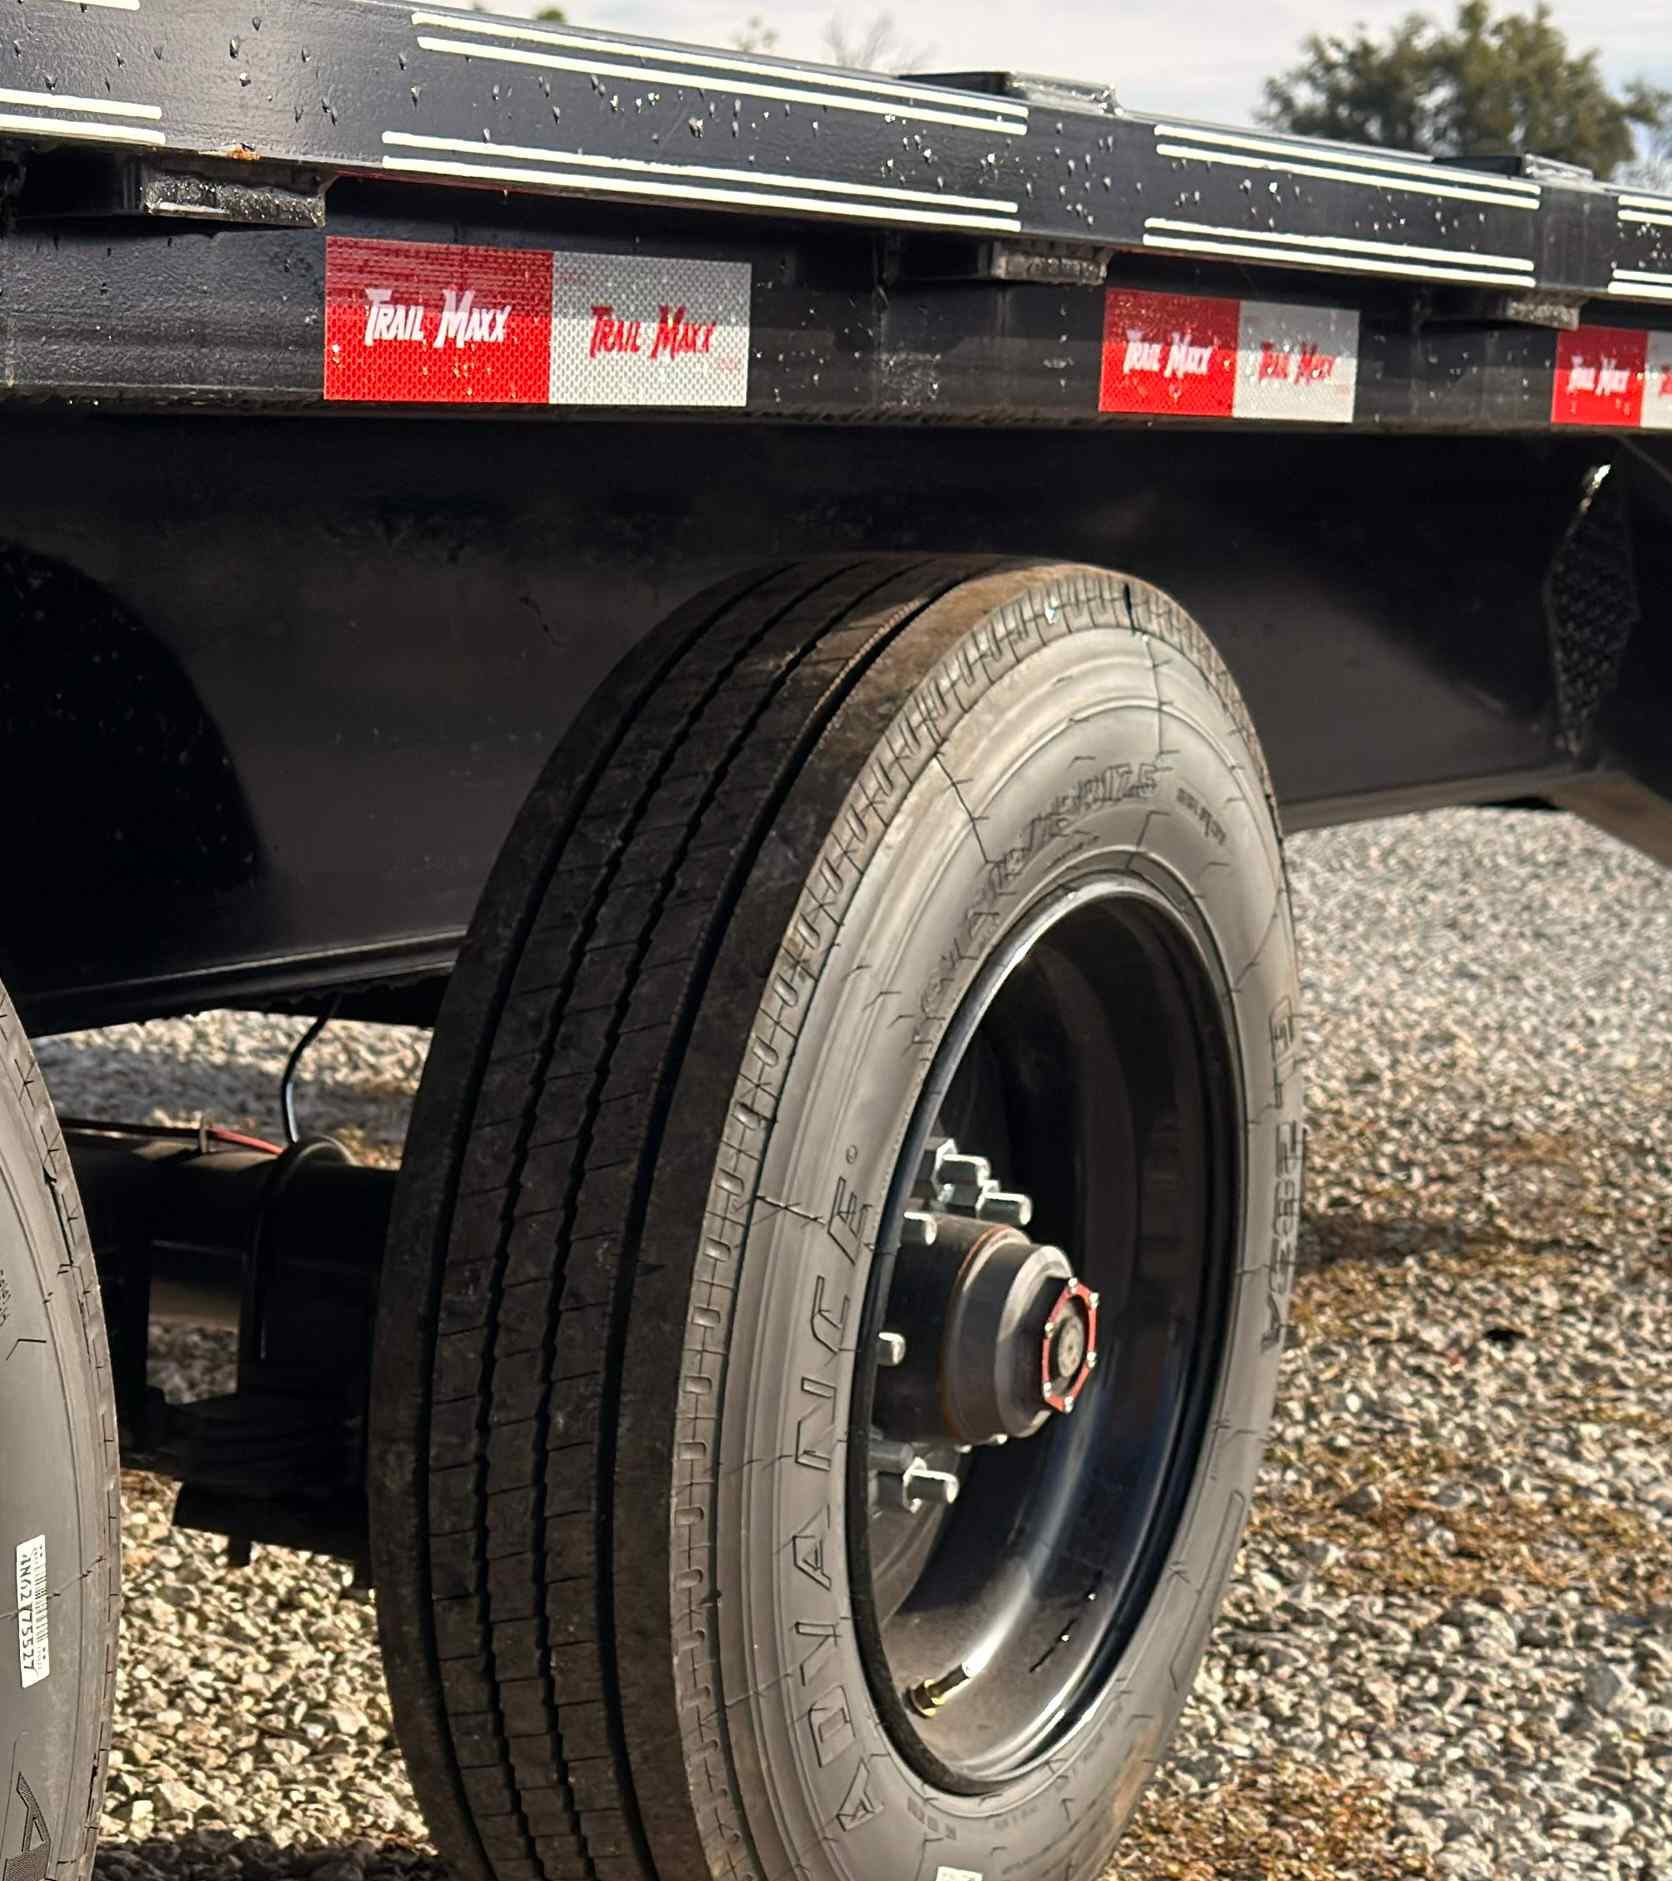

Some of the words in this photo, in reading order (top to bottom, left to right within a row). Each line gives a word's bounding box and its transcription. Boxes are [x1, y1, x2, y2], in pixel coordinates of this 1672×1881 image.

[364, 288, 424, 347] TRAIL
[433, 289, 511, 348] MAXX
[590, 306, 642, 360] TRAIL
[650, 304, 717, 361] MAXX
